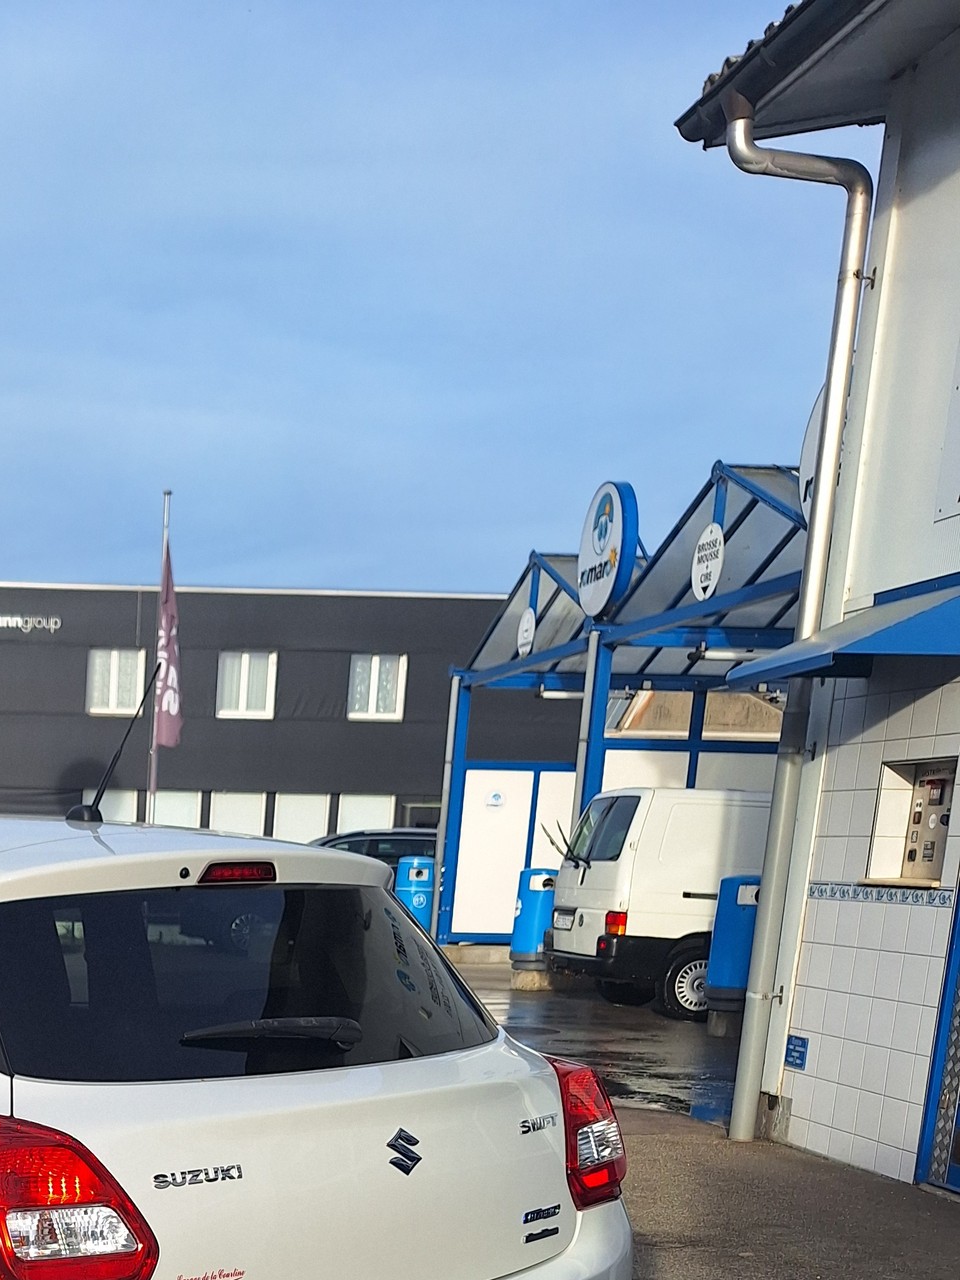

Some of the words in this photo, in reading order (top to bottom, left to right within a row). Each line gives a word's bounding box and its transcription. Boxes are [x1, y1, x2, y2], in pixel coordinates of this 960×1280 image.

[697, 537, 719, 555] BROSSE
[697, 548, 720, 565] MOUSSE
[700, 570, 713, 584] CIRE
[520, 1113, 558, 1135] SWIFT
[153, 1164, 243, 1189] SUZUKI
[210, 1270, 217, 1280] la
